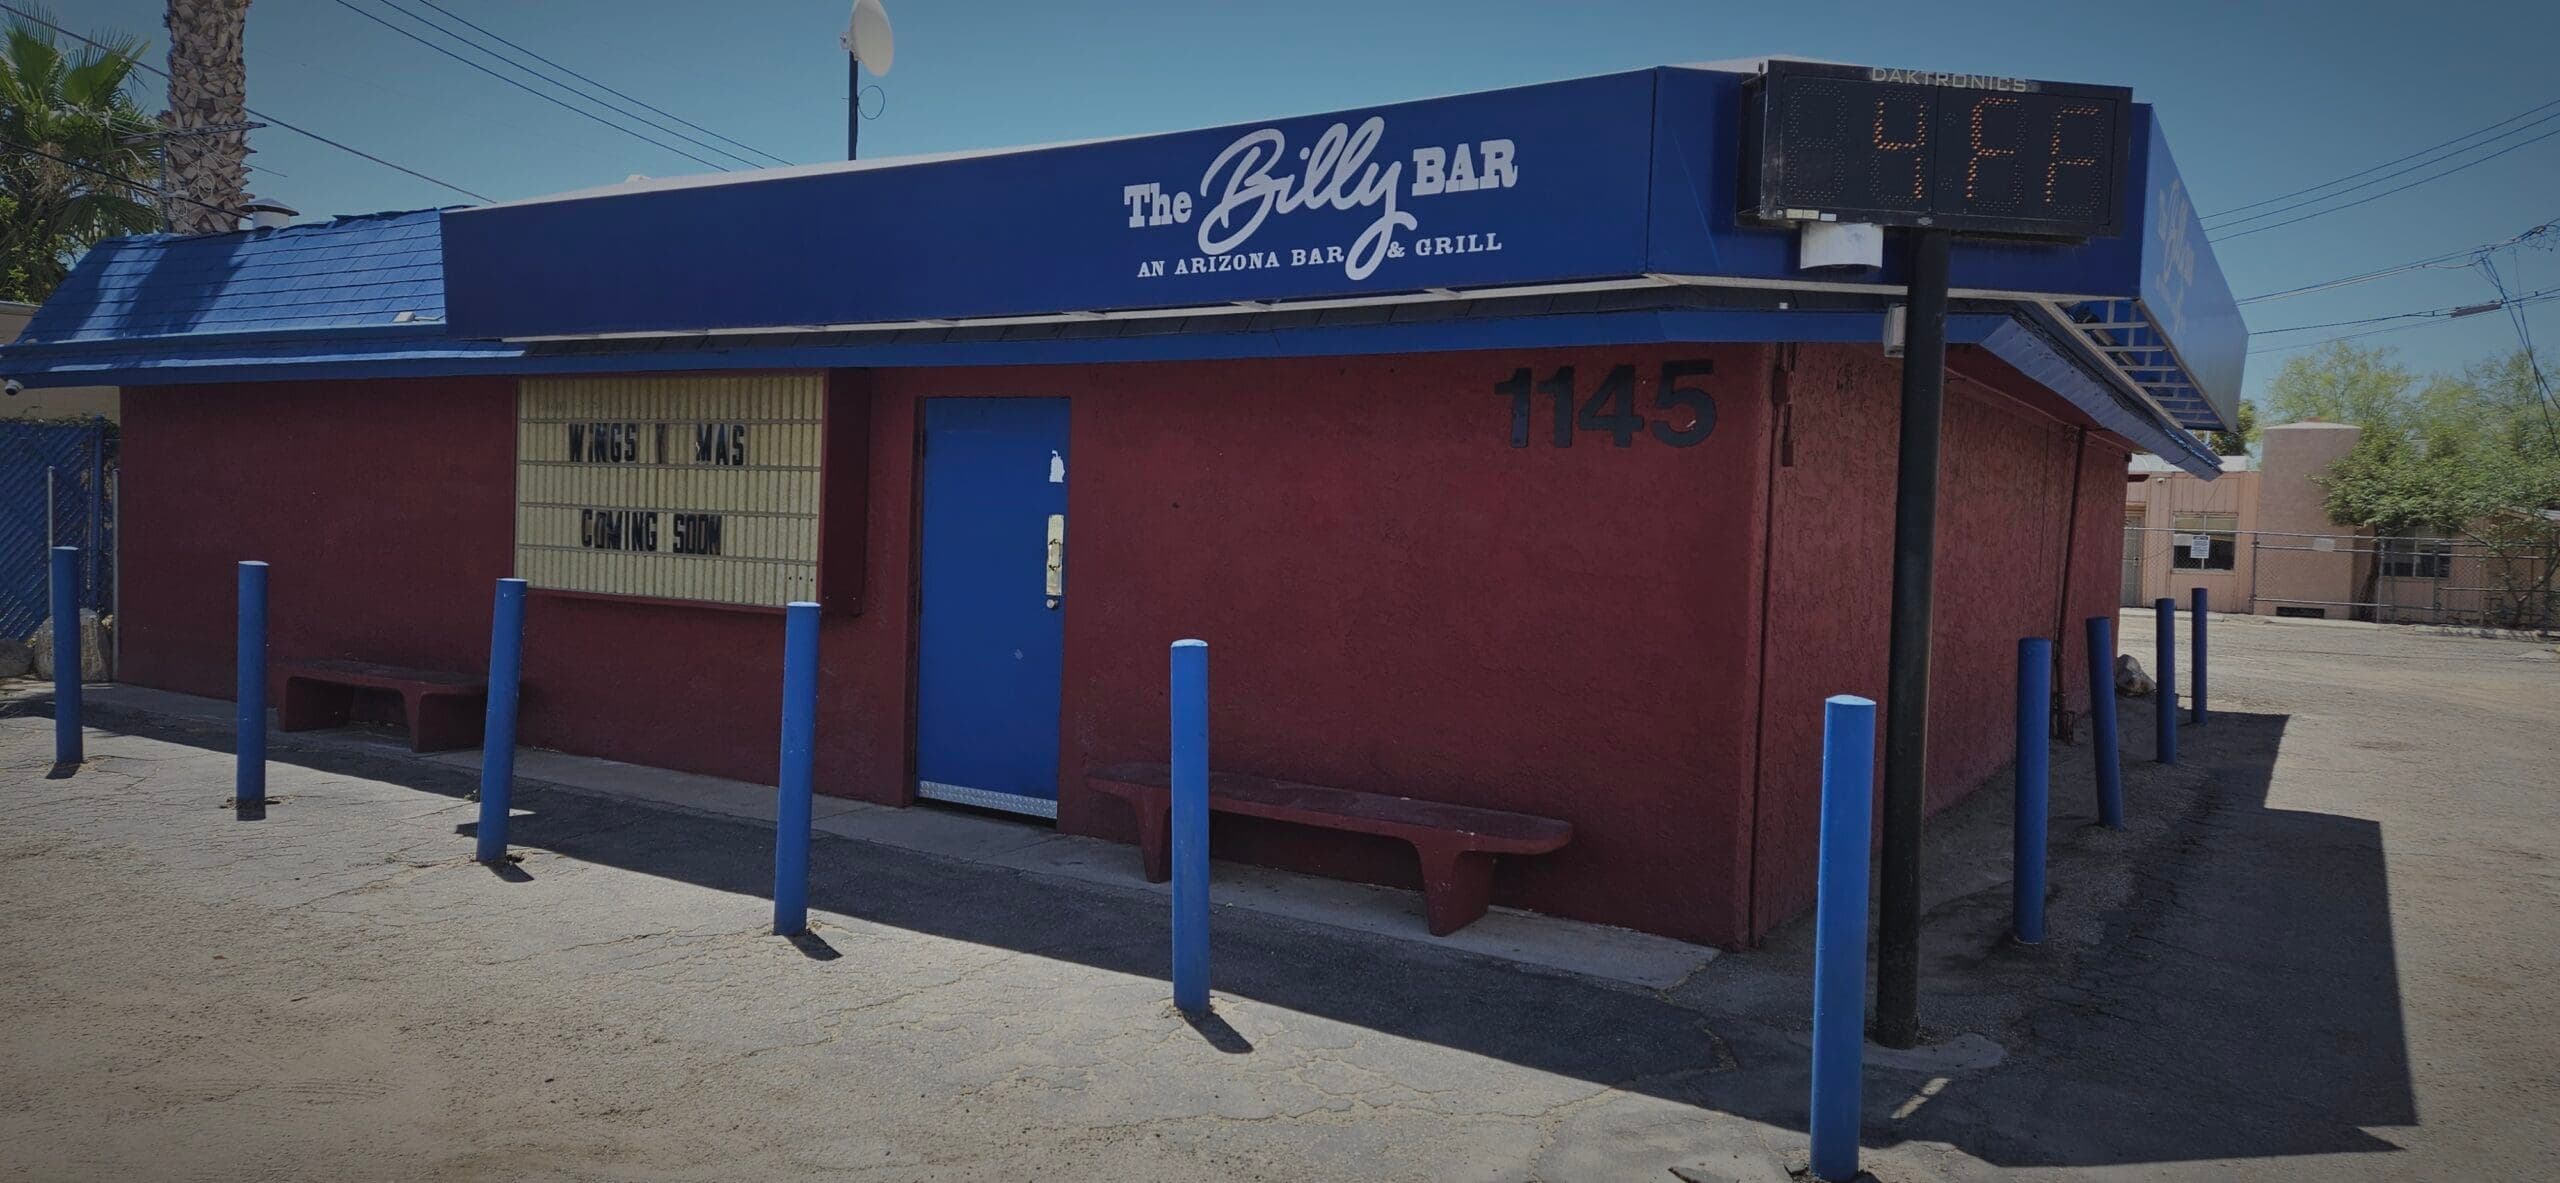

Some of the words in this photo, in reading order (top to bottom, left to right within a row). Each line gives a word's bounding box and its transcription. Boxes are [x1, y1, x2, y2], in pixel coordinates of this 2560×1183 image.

[1872, 67, 2028, 92] DAKTRONICS
[1123, 182, 1193, 229] The
[1196, 116, 1418, 281] Billy
[1411, 138, 1519, 197] BAR
[1136, 260, 1166, 278] AN
[1174, 251, 1281, 276] ARIZONA
[1290, 246, 1345, 267] BAR
[1386, 240, 1406, 259] &
[1414, 232, 1503, 257] GRILL
[1493, 358, 1718, 449] 1145
[568, 422, 637, 463] WINGS
[695, 423, 745, 466] MAS
[580, 508, 657, 552] COMING
[672, 513, 722, 556] SOON
